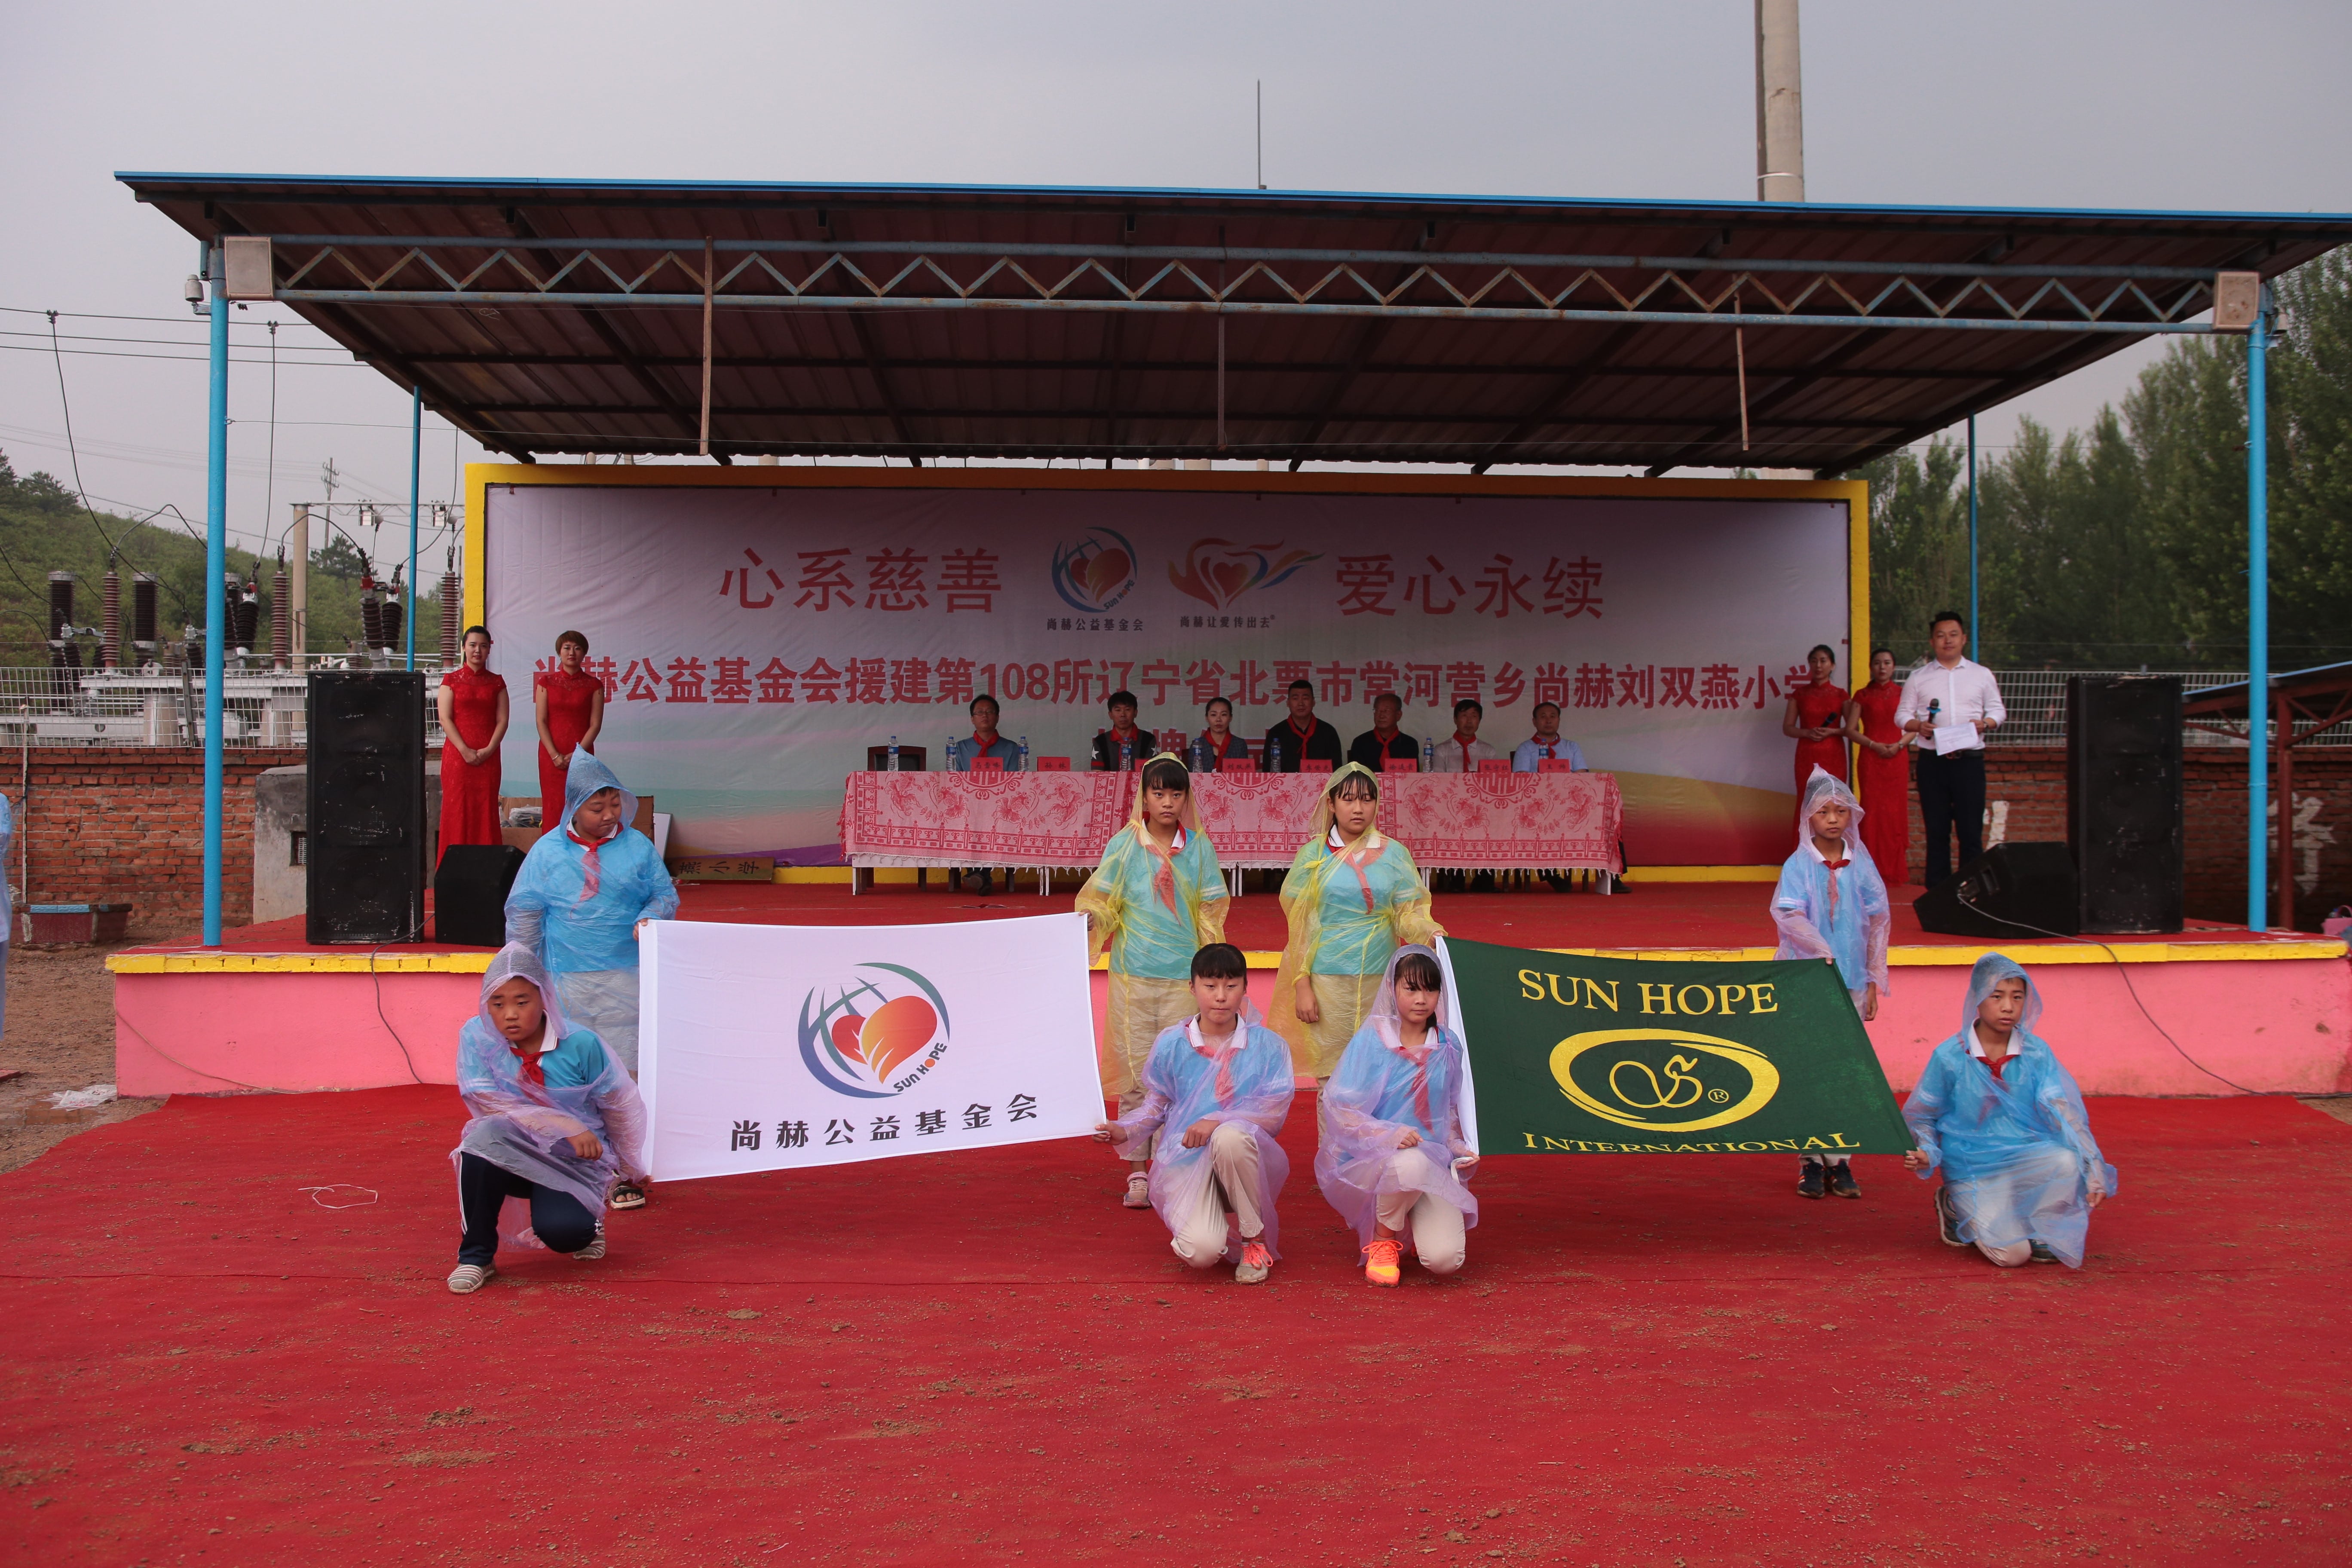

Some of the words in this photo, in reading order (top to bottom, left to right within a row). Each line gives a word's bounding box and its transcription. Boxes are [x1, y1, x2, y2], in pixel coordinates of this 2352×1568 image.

[720, 548, 1001, 613] 心系慈善
[1336, 553, 1603, 619] 爱心永续
[1047, 618, 1143, 631] 尚赫公益基金会
[667, 861, 760, 875] 燕小学
[1517, 969, 1620, 1012] SUN
[1637, 983, 1779, 1016] HOPE
[893, 1073, 921, 1092] SUN
[916, 1042, 948, 1075] HOPE
[731, 1093, 1038, 1152] 尚赫公益基金会
[1522, 1132, 1860, 1152] INTERNATIONAL
